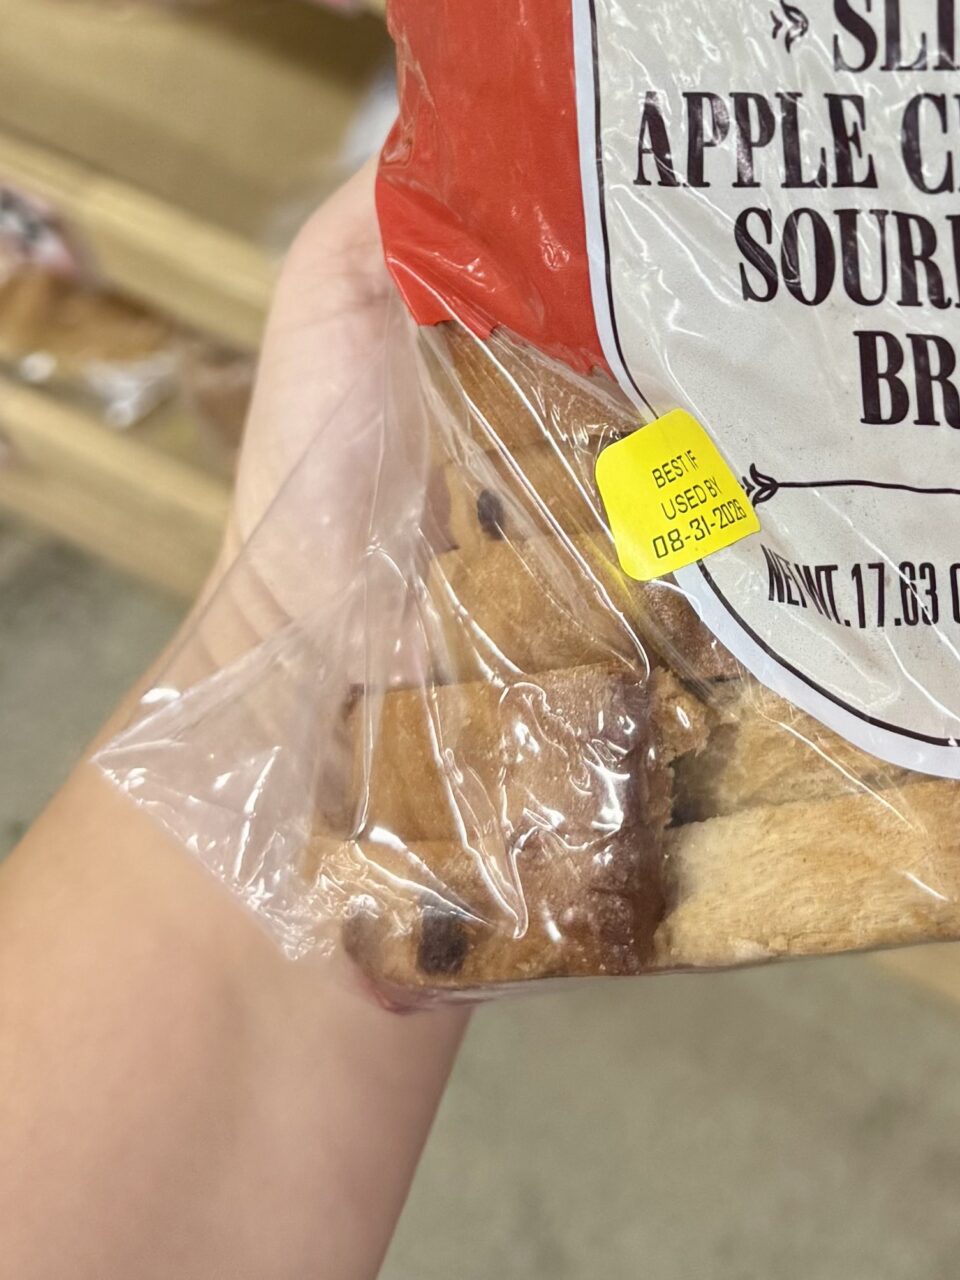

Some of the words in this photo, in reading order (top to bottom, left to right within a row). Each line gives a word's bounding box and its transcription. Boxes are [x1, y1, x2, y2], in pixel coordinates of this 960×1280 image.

[633, 90, 878, 188] APPLE
[652, 455, 689, 488] BEST
[685, 449, 699, 471] IF
[661, 484, 707, 520] USED
[704, 476, 722, 498] BY
[652, 498, 747, 558] 08-31-2026
[851, 561, 938, 629] 17.63
